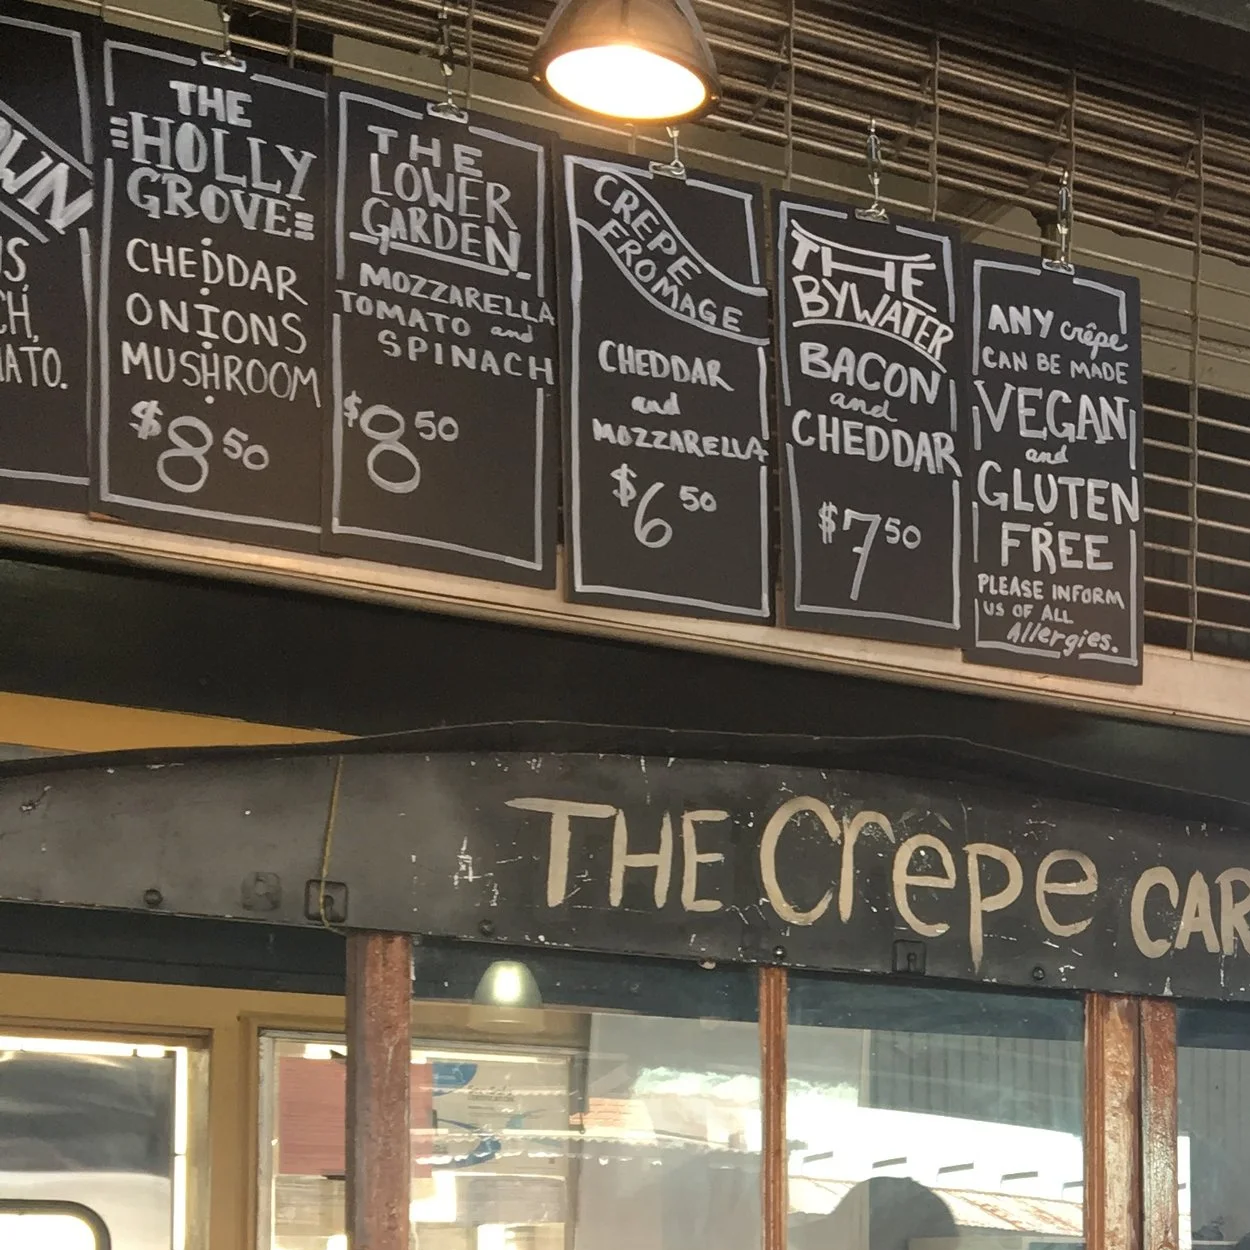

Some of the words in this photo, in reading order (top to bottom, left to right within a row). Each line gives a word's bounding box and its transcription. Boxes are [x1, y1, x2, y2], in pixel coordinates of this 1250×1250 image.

[170, 80, 253, 128] THE
[128, 112, 317, 201] HOLLY
[367, 124, 483, 178] THE
[126, 169, 293, 236] GROVE
[369, 153, 518, 231] LOWER
[362, 197, 523, 269] GARDEN
[594, 175, 701, 285] CREPE
[126, 238, 308, 306] CHEDDAR
[359, 262, 557, 326] MOZZARELLA
[599, 218, 744, 333] FROMAGE
[790, 230, 937, 312] THE
[126, 292, 307, 355] ONIONS
[336, 289, 471, 338] TOMATO
[490, 323, 535, 344] and
[792, 276, 954, 365] BYWATER
[987, 304, 1054, 338] ANY
[1060, 321, 1128, 360] crêpe
[0, 342, 68, 390] ATO.
[121, 341, 322, 408] MUSHROOM
[377, 328, 554, 385] SPINACH
[598, 340, 735, 393] CHEDDAR
[799, 342, 943, 405] BACON
[981, 352, 1029, 372] CAN
[1036, 354, 1062, 375] BE
[1070, 361, 1129, 385] MADE
[631, 392, 681, 415] and
[830, 392, 898, 423] and
[974, 380, 1130, 444] VEGAN
[592, 418, 769, 462] MOZZARELLA
[791, 409, 962, 477] CHEDDAR
[1025, 446, 1069, 465] and
[977, 460, 1139, 523] GLUTEN
[1000, 521, 1114, 574] FREE
[977, 573, 1044, 600] PLEASE
[1052, 584, 1125, 609] INFORM
[982, 600, 1005, 617] US
[1012, 605, 1032, 620] OF
[1041, 608, 1074, 625] ALL
[505, 797, 732, 913] THE
